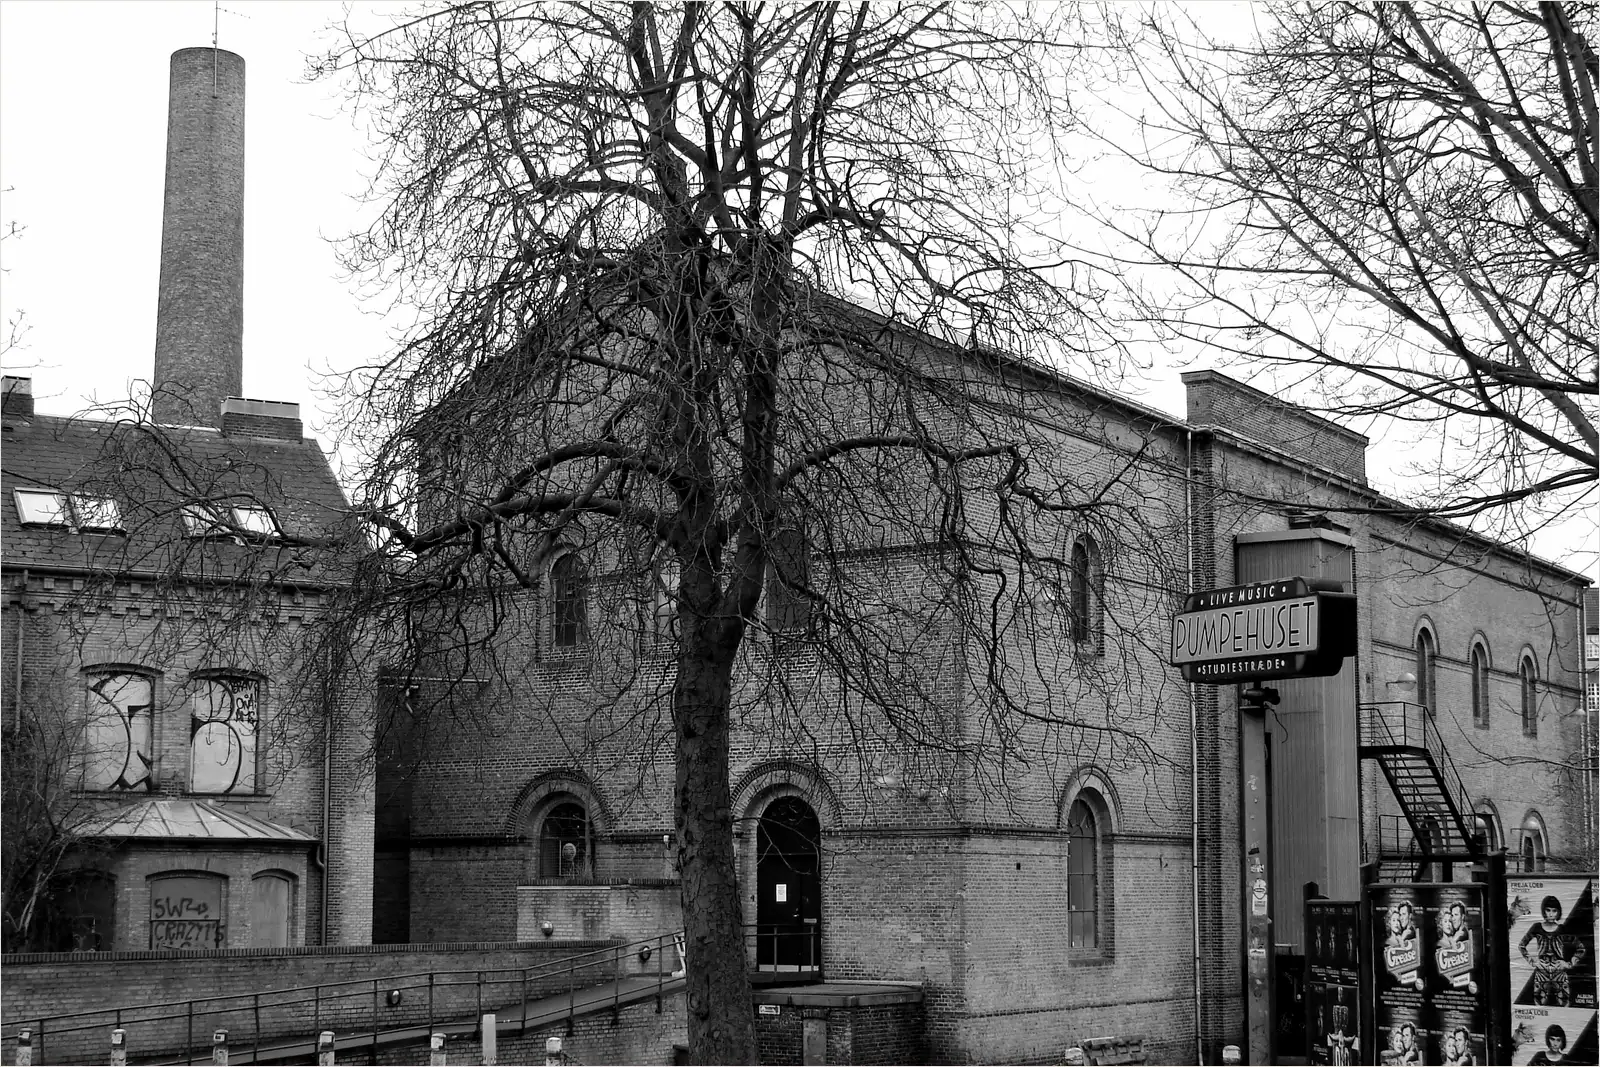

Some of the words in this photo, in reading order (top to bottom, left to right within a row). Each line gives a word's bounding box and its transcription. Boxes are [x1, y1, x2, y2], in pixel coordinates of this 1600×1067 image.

[1210, 592, 1234, 606] LIVE
[1238, 585, 1276, 602] MUSIC
[1175, 601, 1315, 658] PUMPEHUSET
[1201, 658, 1280, 675] STUDIESTRÆDE
[1387, 947, 1417, 967] Grease
[1439, 949, 1469, 970] Grease
